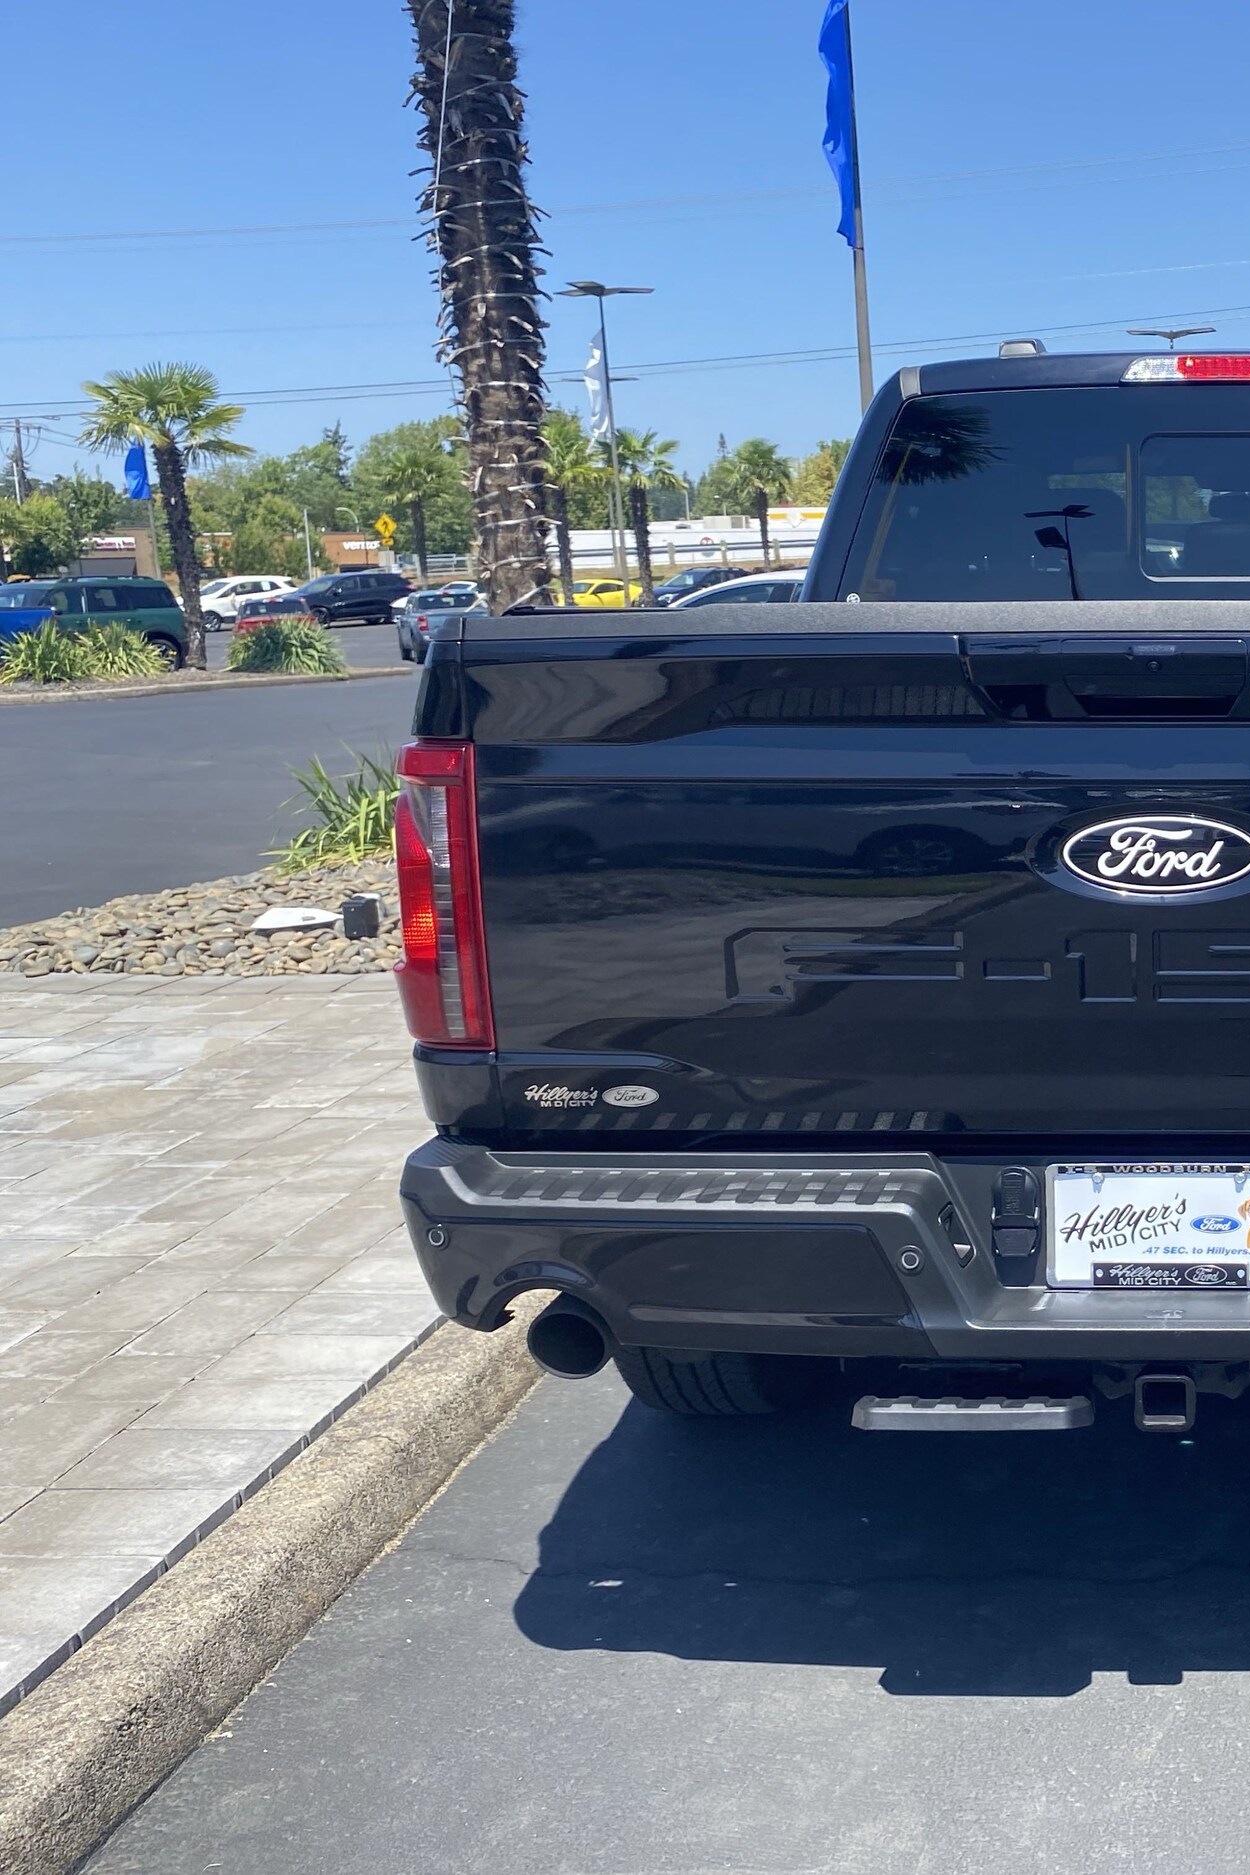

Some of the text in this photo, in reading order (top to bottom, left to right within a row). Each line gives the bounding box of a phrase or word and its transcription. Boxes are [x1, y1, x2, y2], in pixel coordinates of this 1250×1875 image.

[1097, 826, 1225, 877] Ford
[524, 1083, 598, 1108] Hillyer's
[568, 1099, 596, 1108] CITY
[613, 1089, 647, 1102] Ford
[1065, 1165, 1098, 1174] I-5
[1113, 1165, 1227, 1174] WOODBURN
[1059, 1192, 1187, 1245] Hillyer's
[1199, 1215, 1232, 1231] Ford
[1088, 1218, 1182, 1253] MID CITY
[1162, 1246, 1189, 1255] SEC.
[1191, 1247, 1204, 1255] to
[1109, 1264, 1179, 1281] Hillyer's
[1192, 1266, 1220, 1282] Ford
[1118, 1277, 1182, 1286] MID CITY
